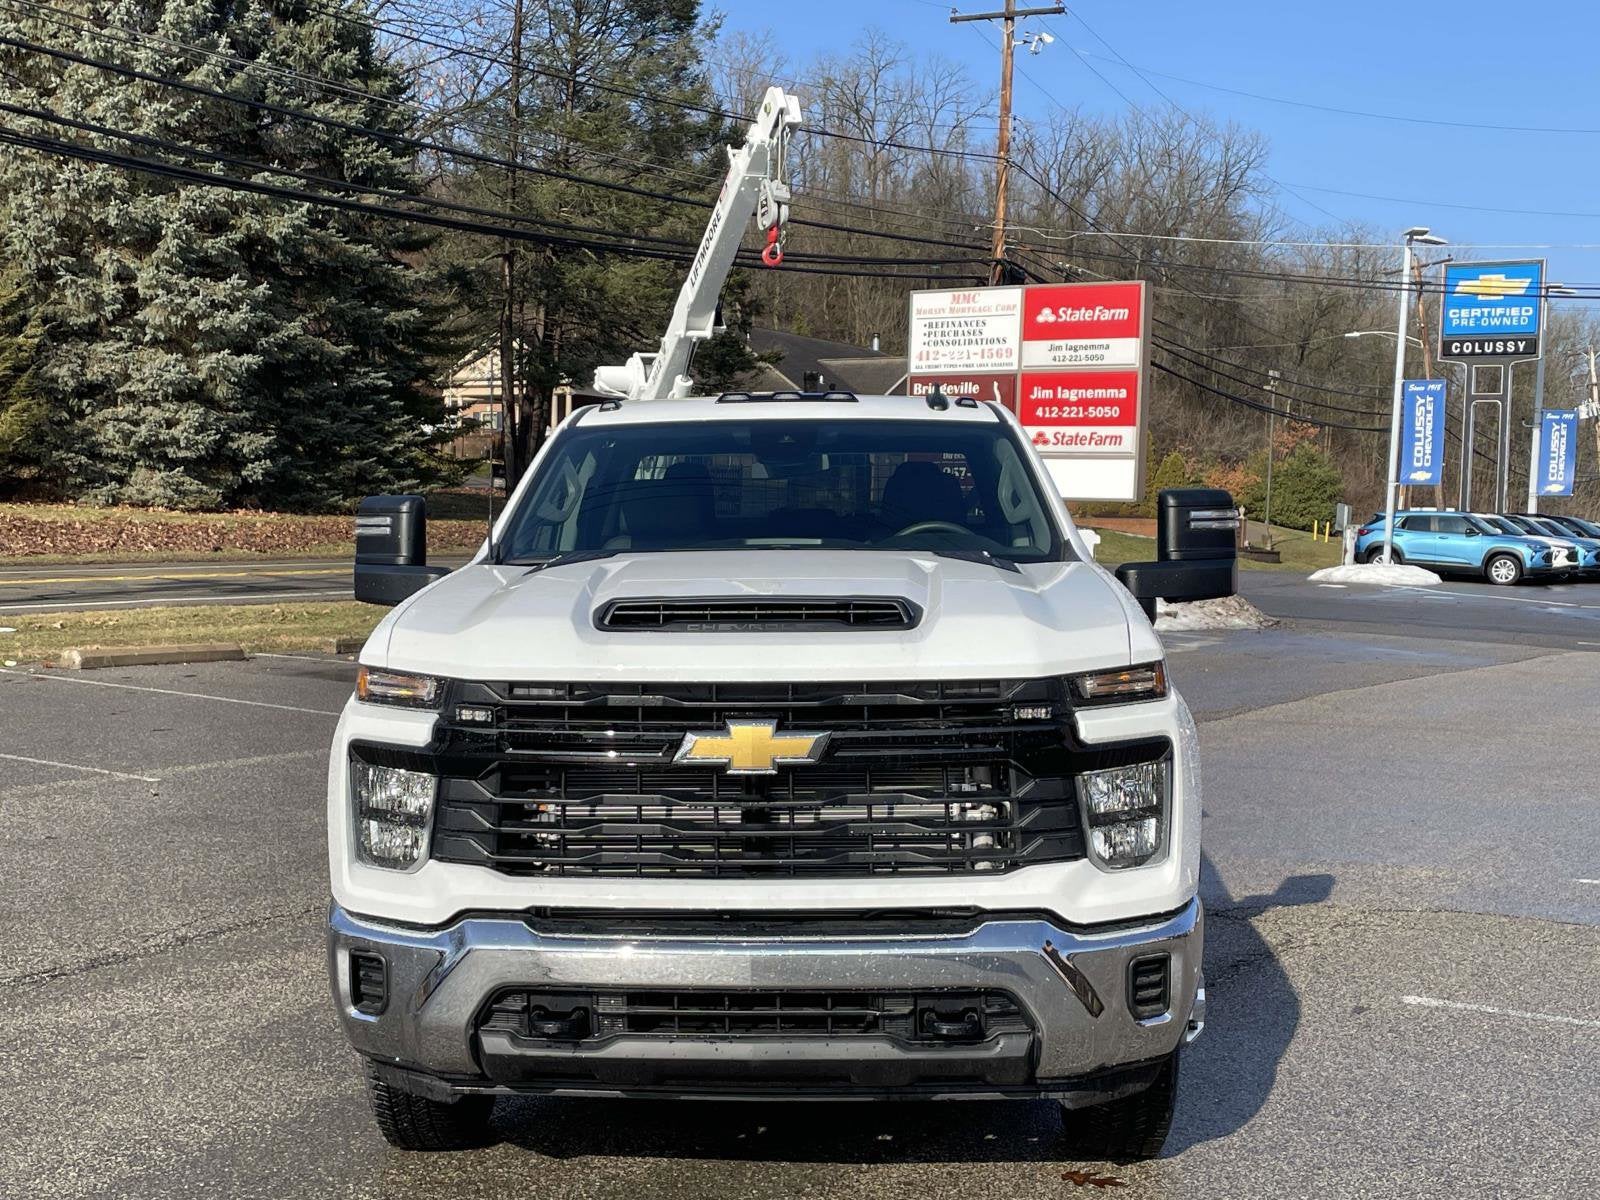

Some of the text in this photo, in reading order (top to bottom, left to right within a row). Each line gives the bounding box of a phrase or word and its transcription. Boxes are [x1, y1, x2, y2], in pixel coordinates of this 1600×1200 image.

[690, 209, 721, 287] LIFTMOORE
[951, 293, 980, 304] MMC
[1449, 307, 1533, 318] CERTIFIED
[928, 320, 987, 329] REFINANCES
[1452, 316, 1528, 327] PRE-OWNED
[927, 329, 983, 338] PURCHASES
[927, 337, 1007, 347] CONSOLIDATIONS
[1048, 344, 1063, 352] Jim
[1451, 341, 1526, 353] COLUSSY
[916, 347, 1013, 361] 412-221-1569
[913, 381, 980, 396] Brigeville
[1030, 386, 1054, 400] Jim
[1036, 406, 1120, 418] 412-221-5050
[1413, 395, 1426, 467] COLUSSY
[1424, 395, 1434, 467] CHEVROLET
[1549, 422, 1560, 480] COLUSSY
